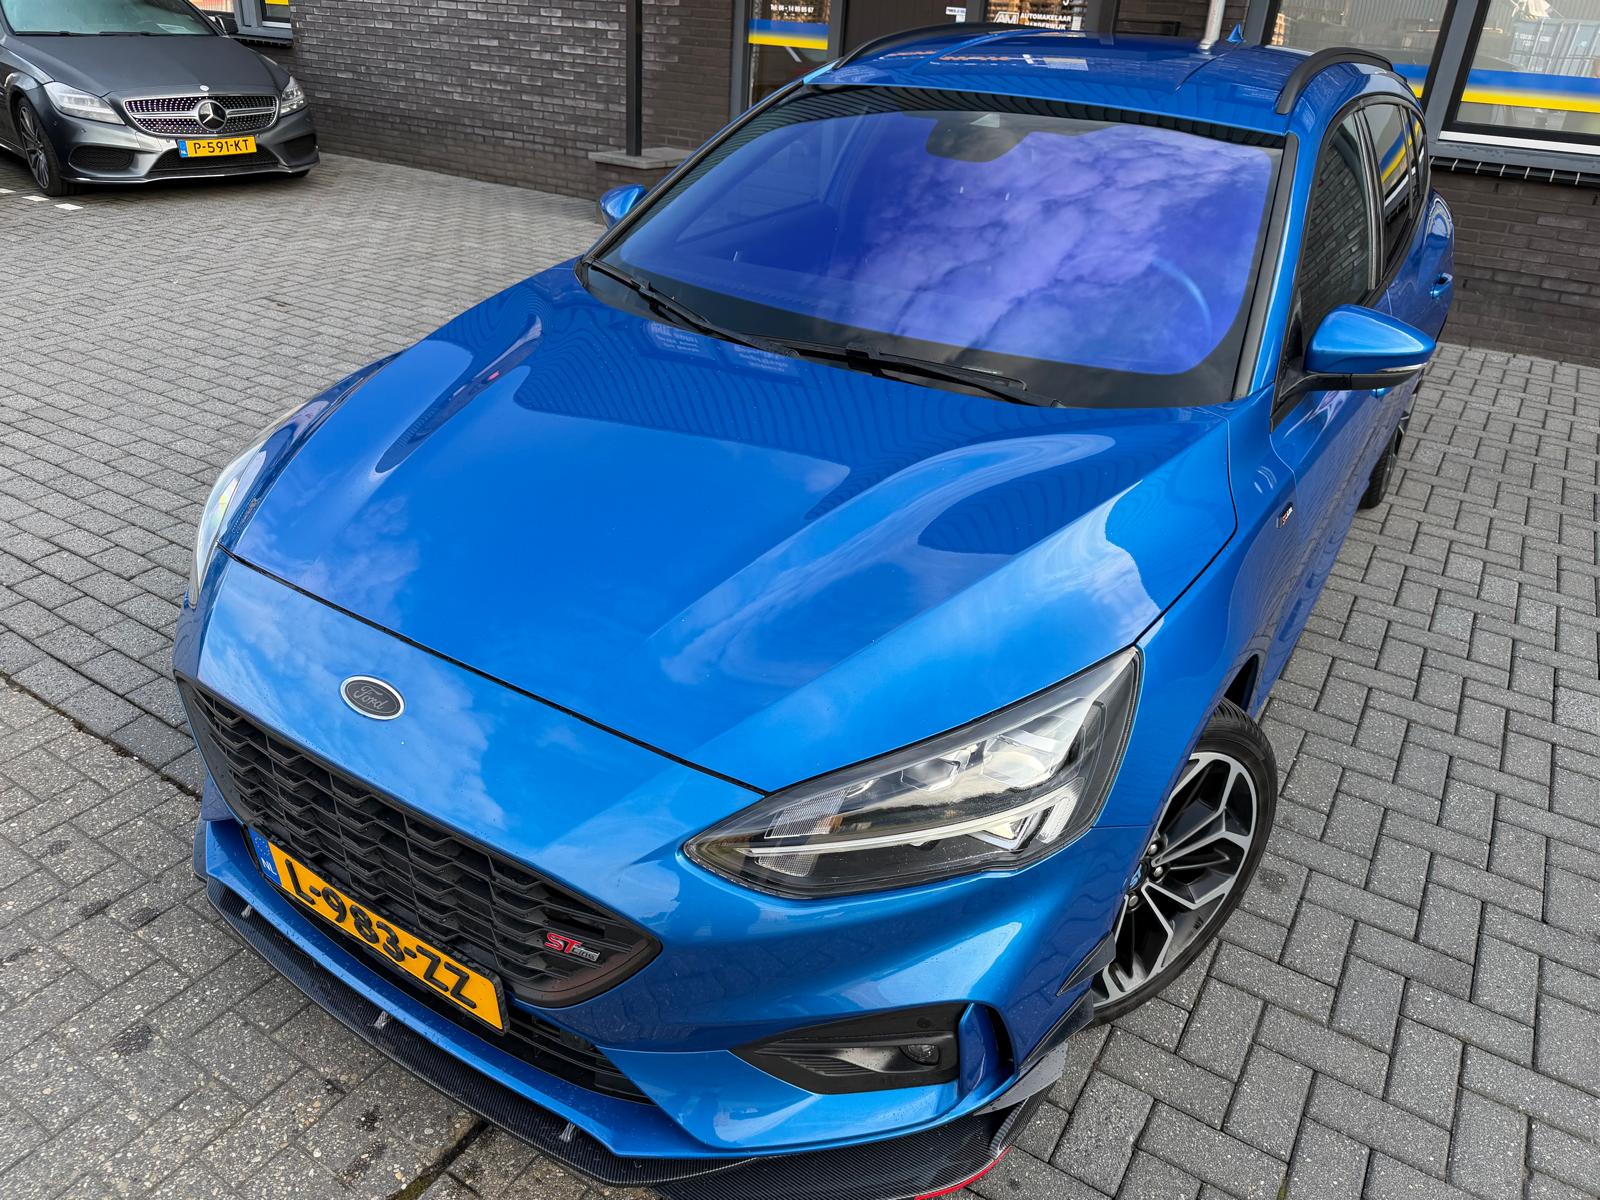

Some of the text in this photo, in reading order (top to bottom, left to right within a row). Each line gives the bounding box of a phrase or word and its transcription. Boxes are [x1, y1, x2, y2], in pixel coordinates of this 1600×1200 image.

[1020, 13, 1071, 22] AUTOMAKELAAR
[193, 139, 249, 154] P-591-KT
[353, 686, 389, 710] Ford
[261, 857, 477, 1009] NL L-983-ZZ
[544, 932, 583, 954] ST
